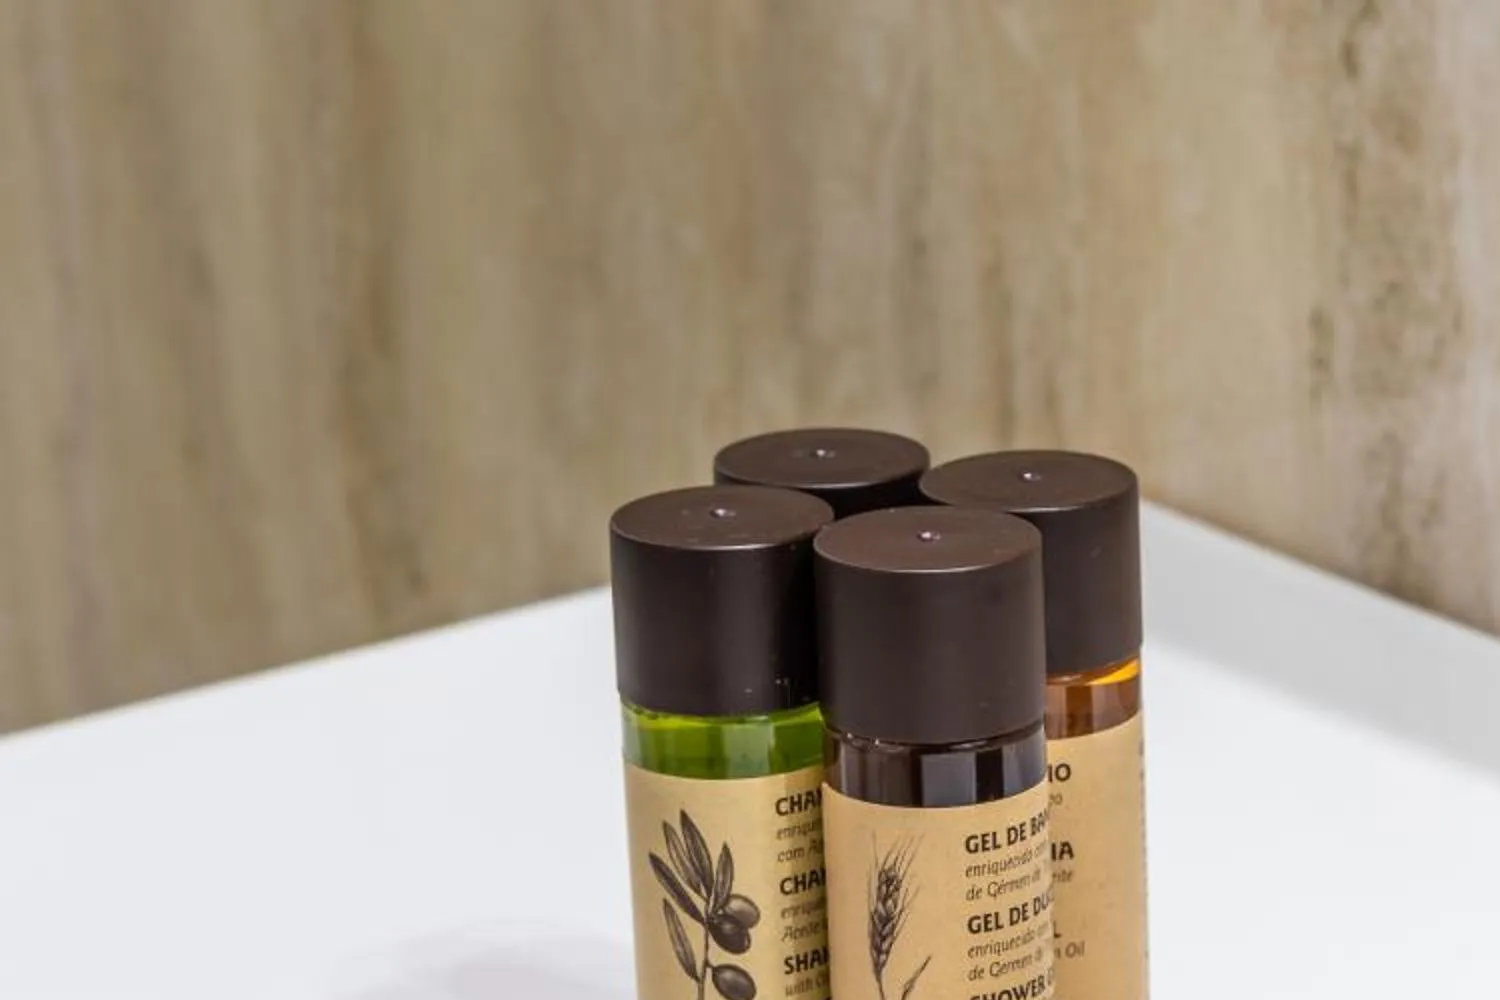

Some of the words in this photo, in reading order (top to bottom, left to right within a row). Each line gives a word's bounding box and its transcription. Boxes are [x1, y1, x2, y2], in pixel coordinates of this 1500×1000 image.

[965, 831, 1002, 855] GEL
[1006, 821, 1028, 848] DE
[965, 884, 983, 902] de
[967, 911, 1005, 936] GEL
[1009, 901, 1030, 928] DE
[967, 963, 985, 982] de
